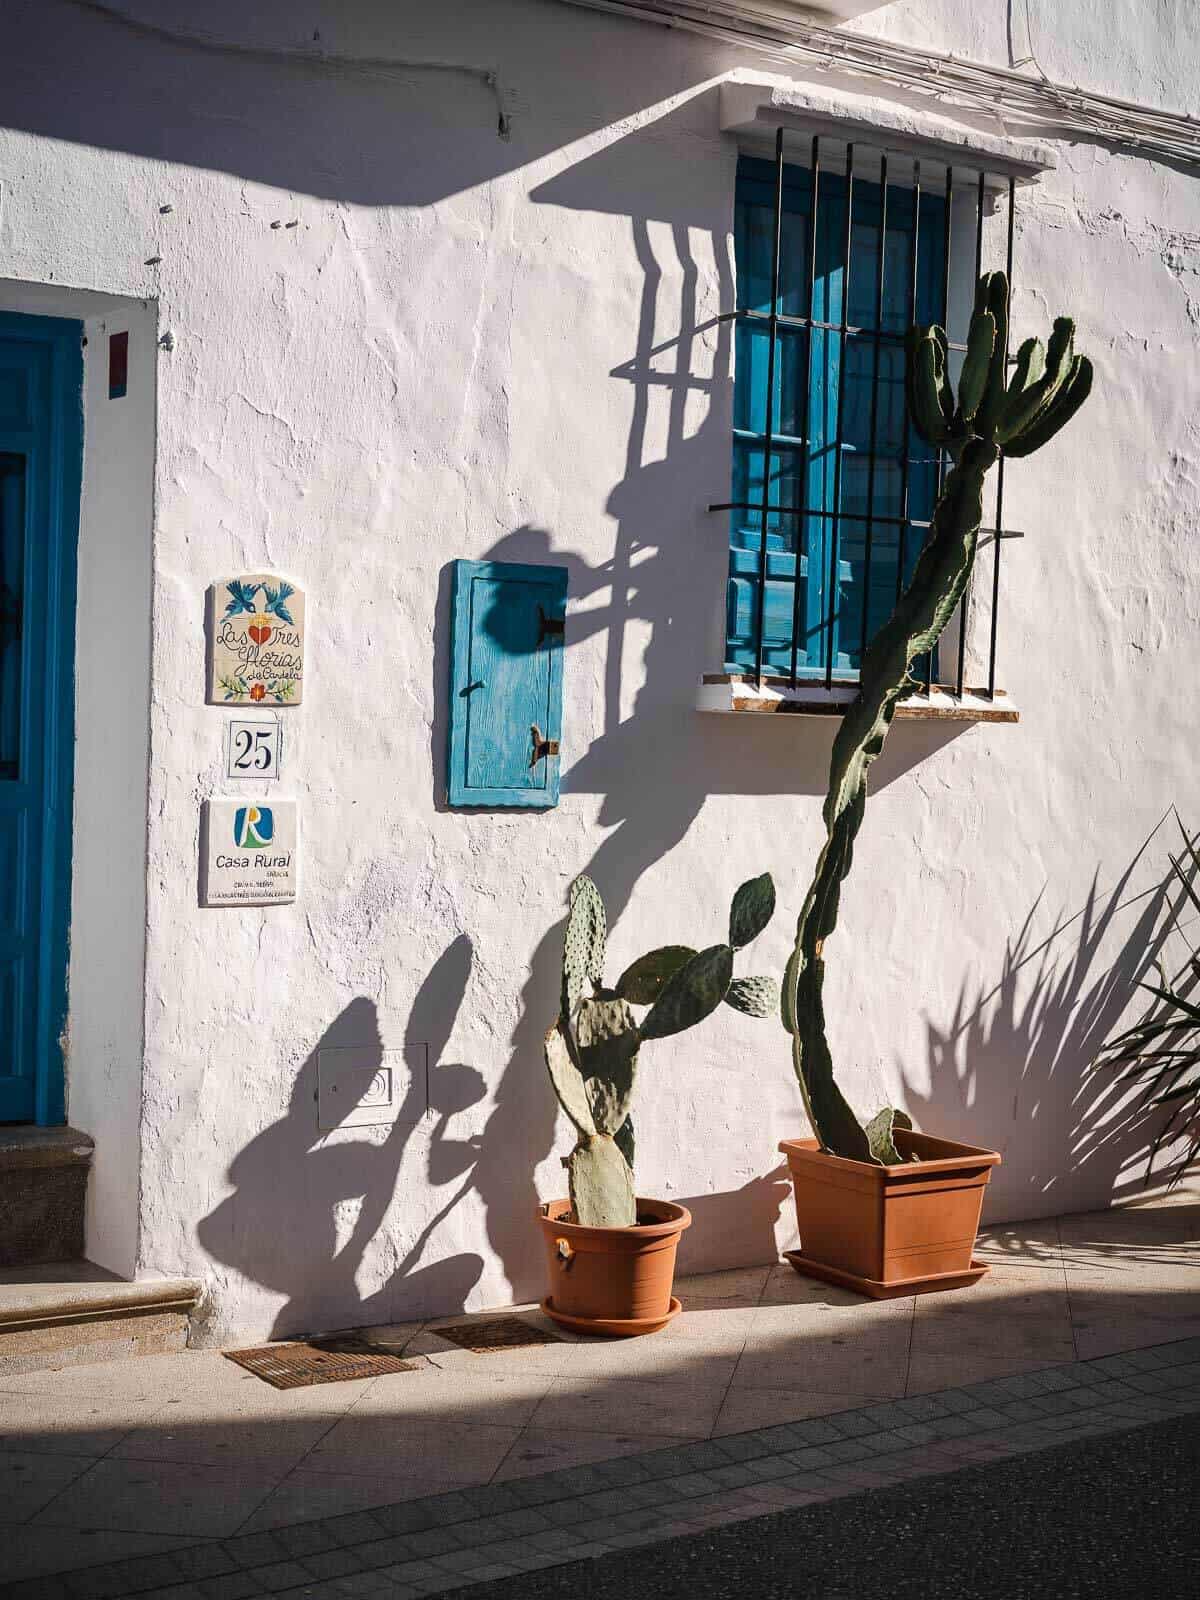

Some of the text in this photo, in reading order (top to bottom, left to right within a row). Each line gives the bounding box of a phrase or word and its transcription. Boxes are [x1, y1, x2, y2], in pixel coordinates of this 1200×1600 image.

[216, 622, 300, 651] Las Tres
[234, 729, 272, 770] 25
[216, 854, 291, 869] Casa Rural
